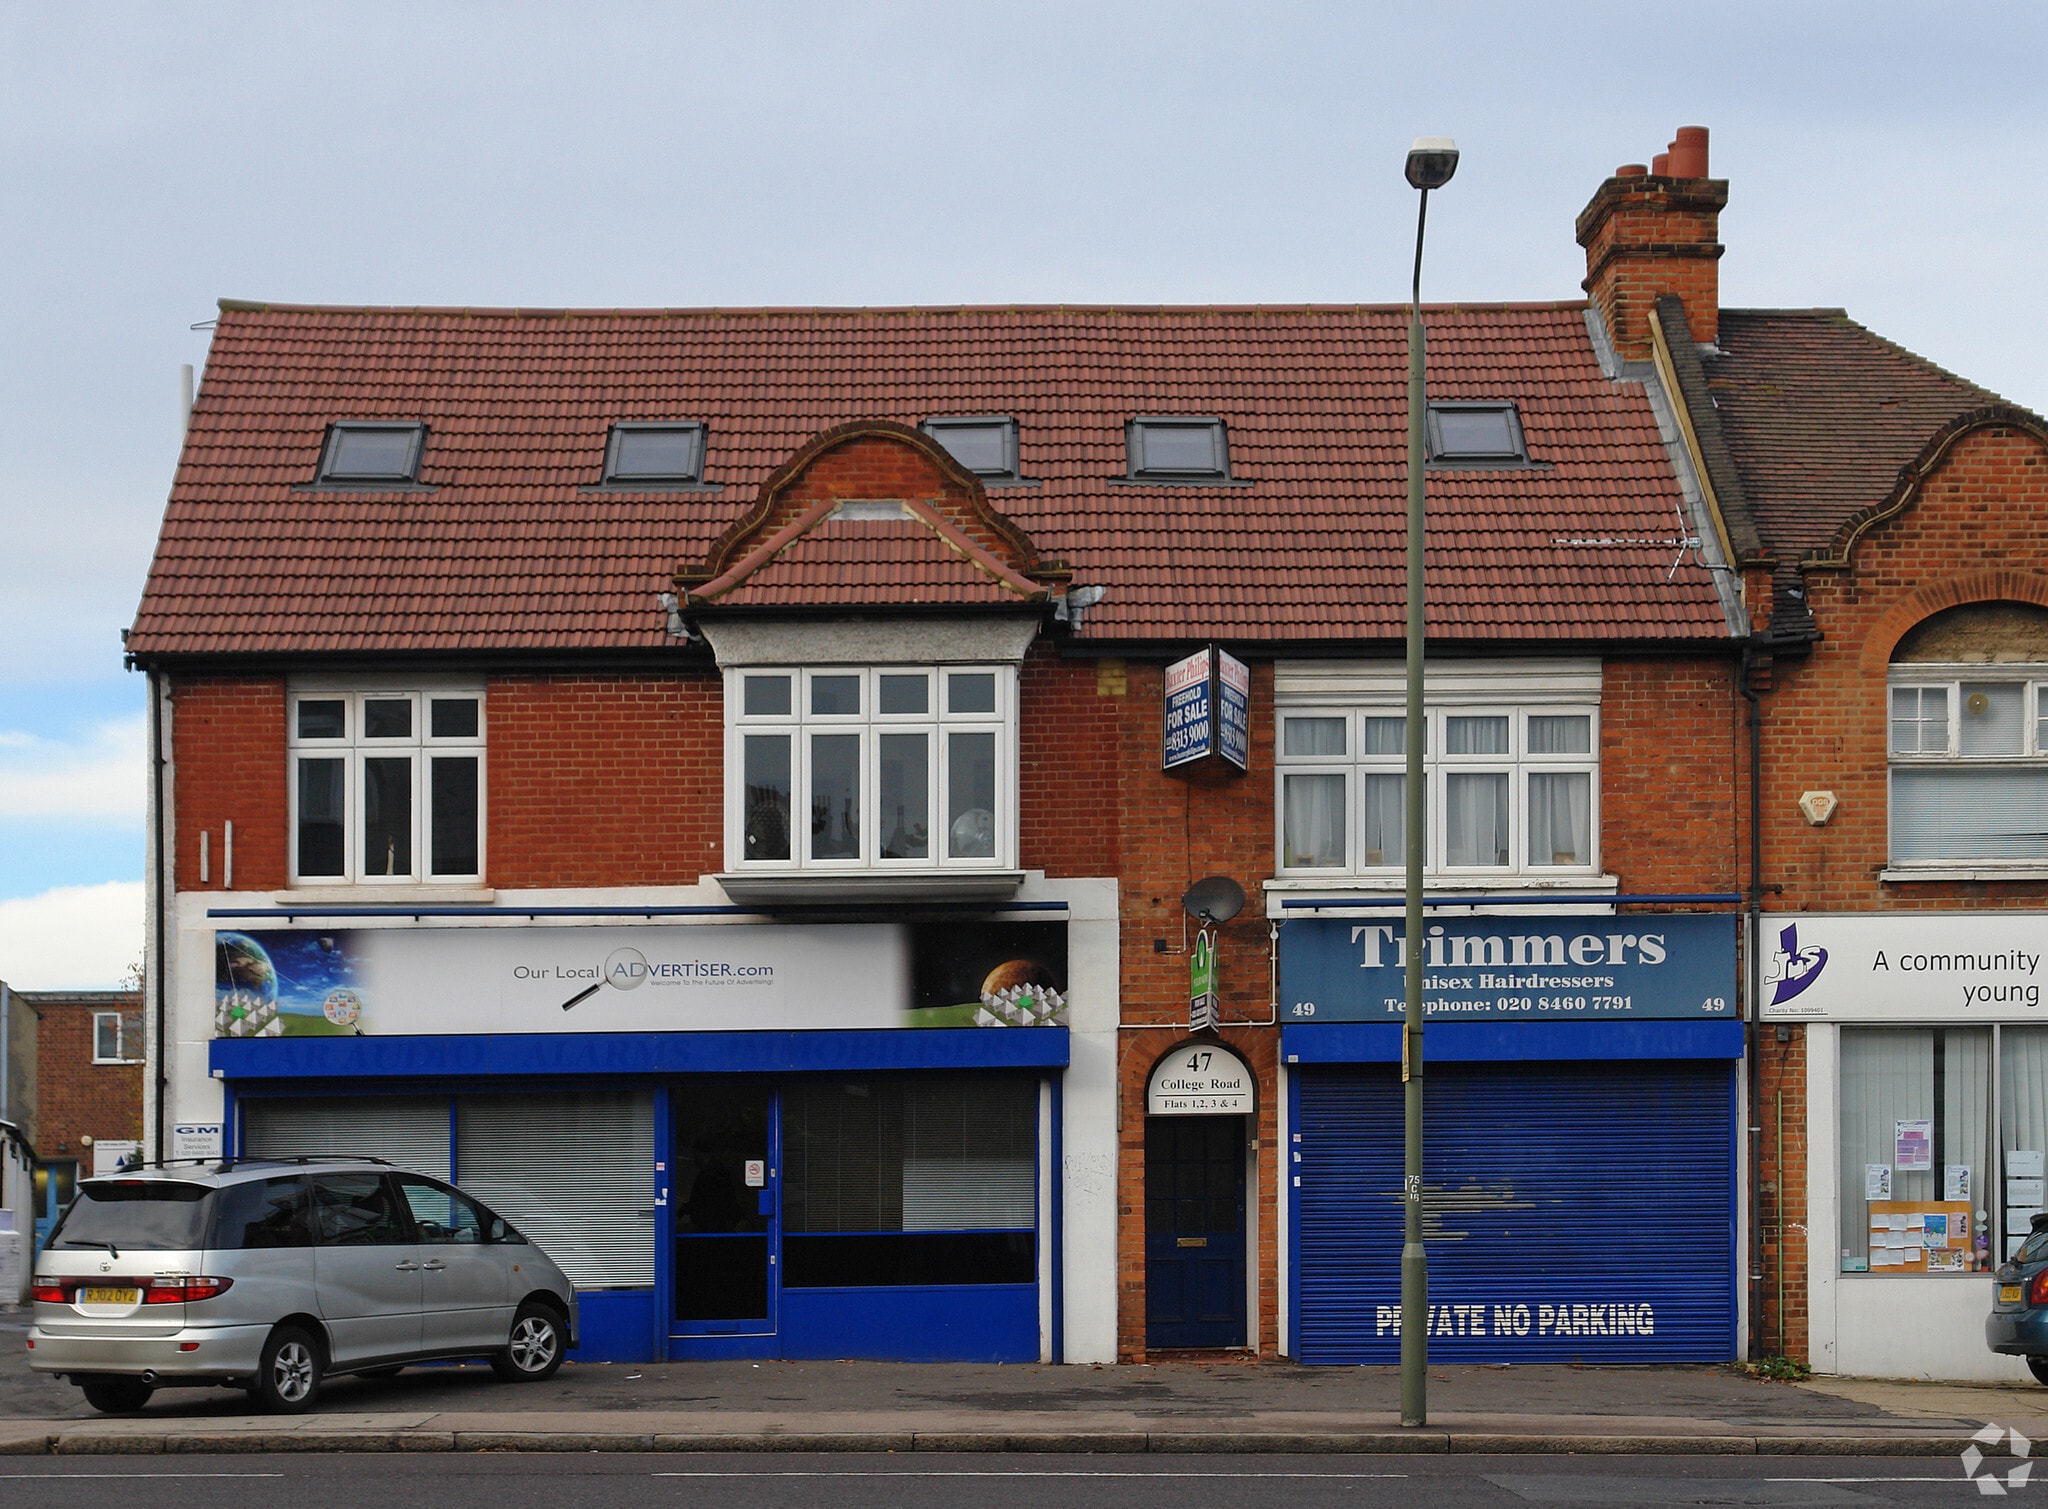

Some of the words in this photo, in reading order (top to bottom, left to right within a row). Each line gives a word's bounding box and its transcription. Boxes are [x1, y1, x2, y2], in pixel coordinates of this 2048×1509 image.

[1167, 709, 1183, 731] FOR
[1184, 698, 1207, 723] SALE
[1189, 720, 1209, 746] 9000
[1872, 950, 1889, 971] A
[1900, 950, 2041, 976] community
[513, 965, 550, 979] Our
[555, 964, 600, 979] Local
[1402, 975, 1473, 990] nisex
[1478, 973, 1614, 990] Hairdressers
[1963, 984, 2040, 1006] young
[1292, 1002, 1316, 1017] 49
[1497, 997, 1532, 1011] 020
[1537, 996, 1586, 1011] 8460
[1591, 996, 1633, 1010] 7791
[1701, 997, 1726, 1012] 49
[1186, 1053, 1212, 1072] 47
[1161, 1079, 1204, 1092] College
[1211, 1078, 1240, 1088] Road
[1164, 1100, 1187, 1108] Flats
[1211, 1100, 1217, 1108] 3
[1220, 1100, 1229, 1108] &
[1408, 1175, 1420, 1184] 75
[1411, 1184, 1418, 1193] C
[1494, 1303, 1531, 1336] NO
[1538, 1302, 1655, 1336] PARKING
